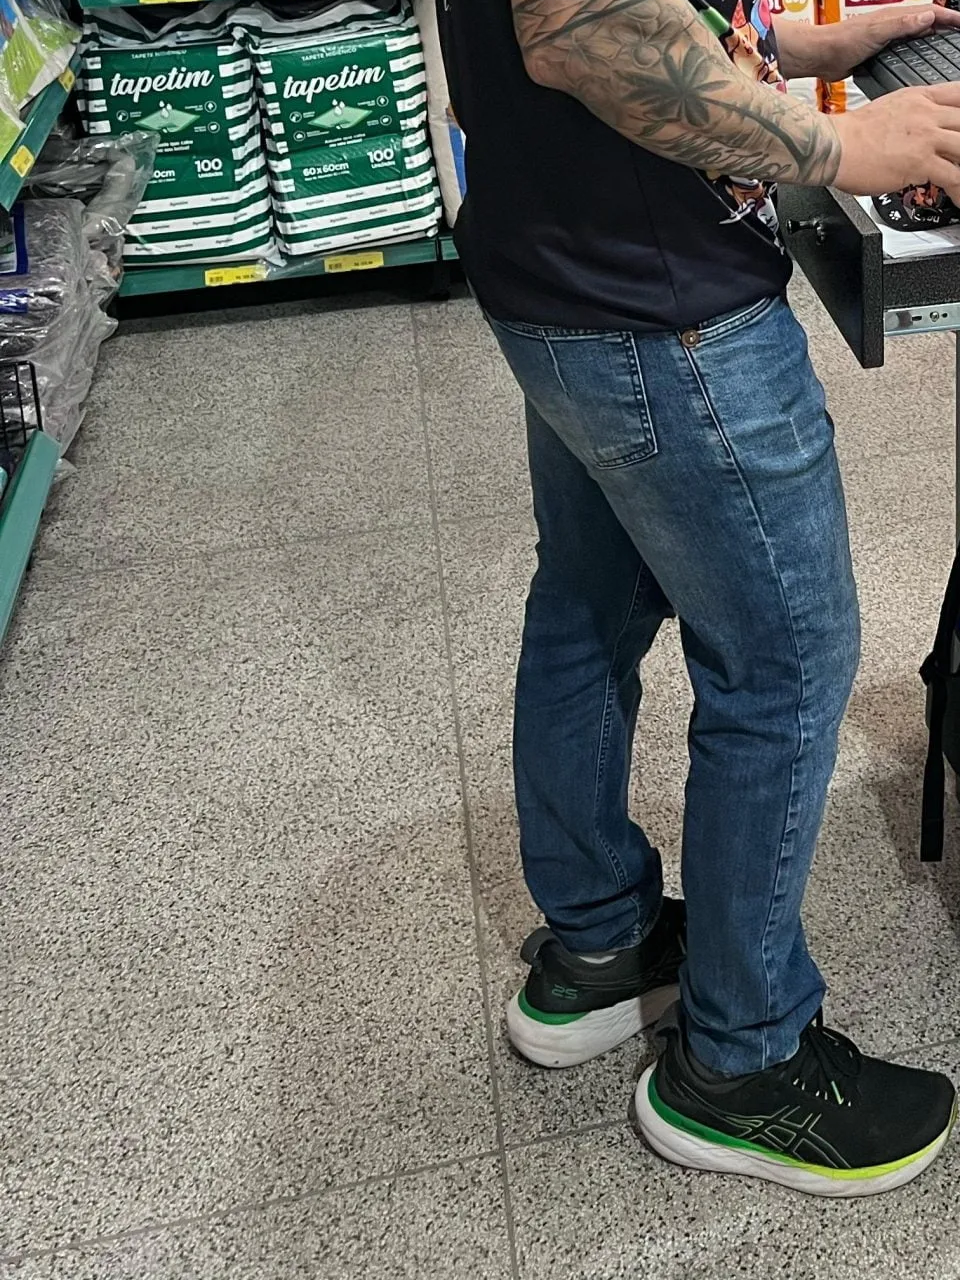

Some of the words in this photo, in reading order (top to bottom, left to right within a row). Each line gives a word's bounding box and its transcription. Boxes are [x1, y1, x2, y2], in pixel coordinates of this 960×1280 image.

[301, 54, 324, 62] TAPETE
[110, 66, 215, 103] tapetim
[282, 64, 386, 104] tapetim
[367, 148, 394, 163] 100
[194, 158, 223, 173] 100
[303, 163, 349, 177] 60x60cm
